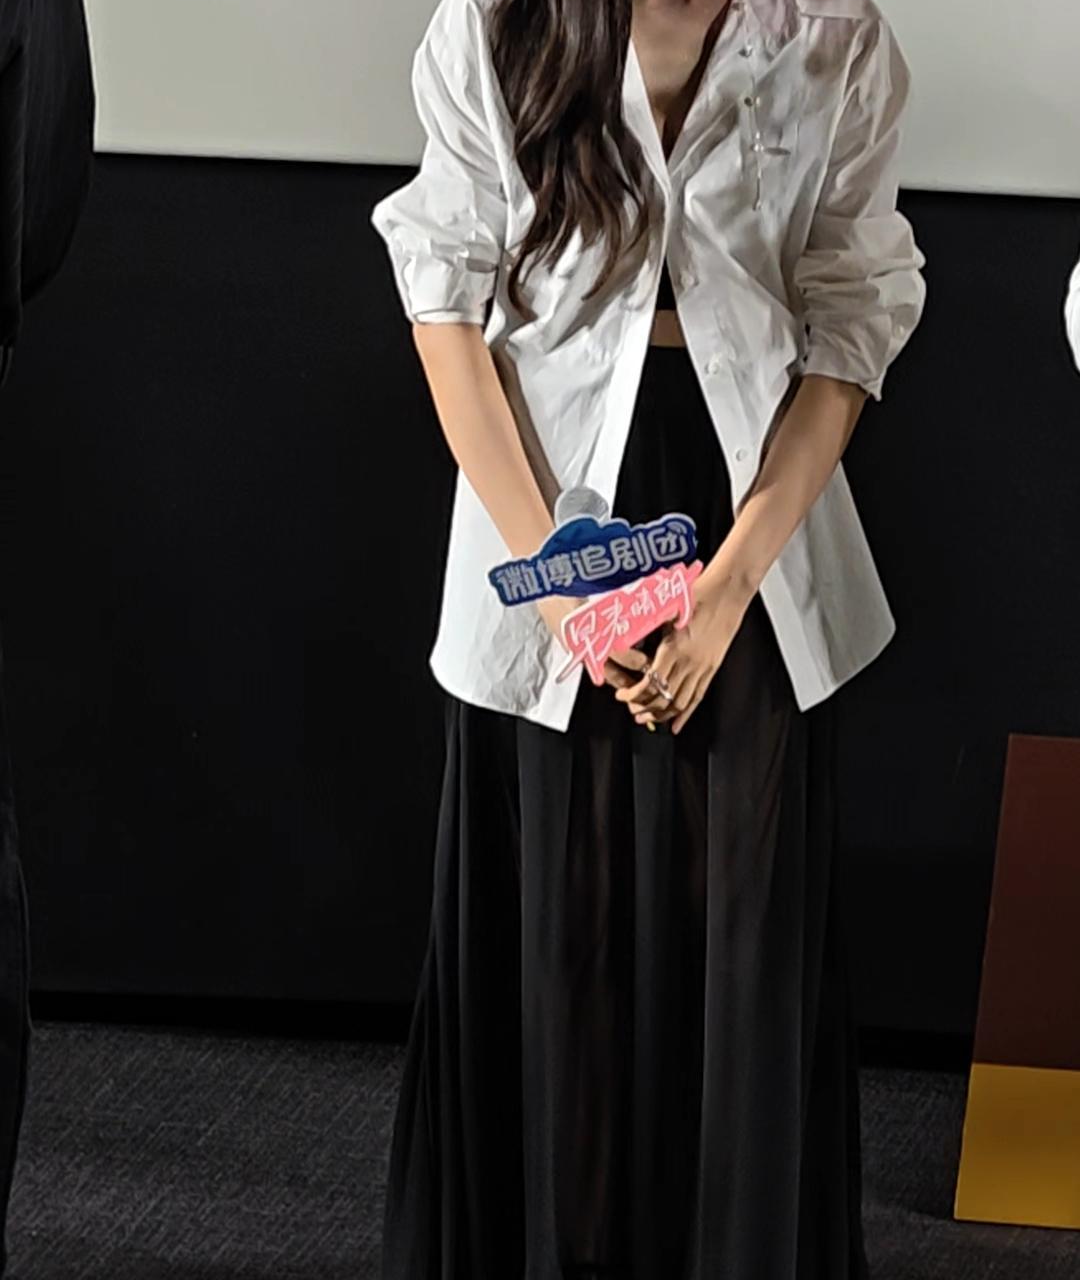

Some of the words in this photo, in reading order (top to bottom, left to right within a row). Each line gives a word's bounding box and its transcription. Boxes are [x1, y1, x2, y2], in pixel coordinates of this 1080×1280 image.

[497, 521, 690, 601] 微博追剧团
